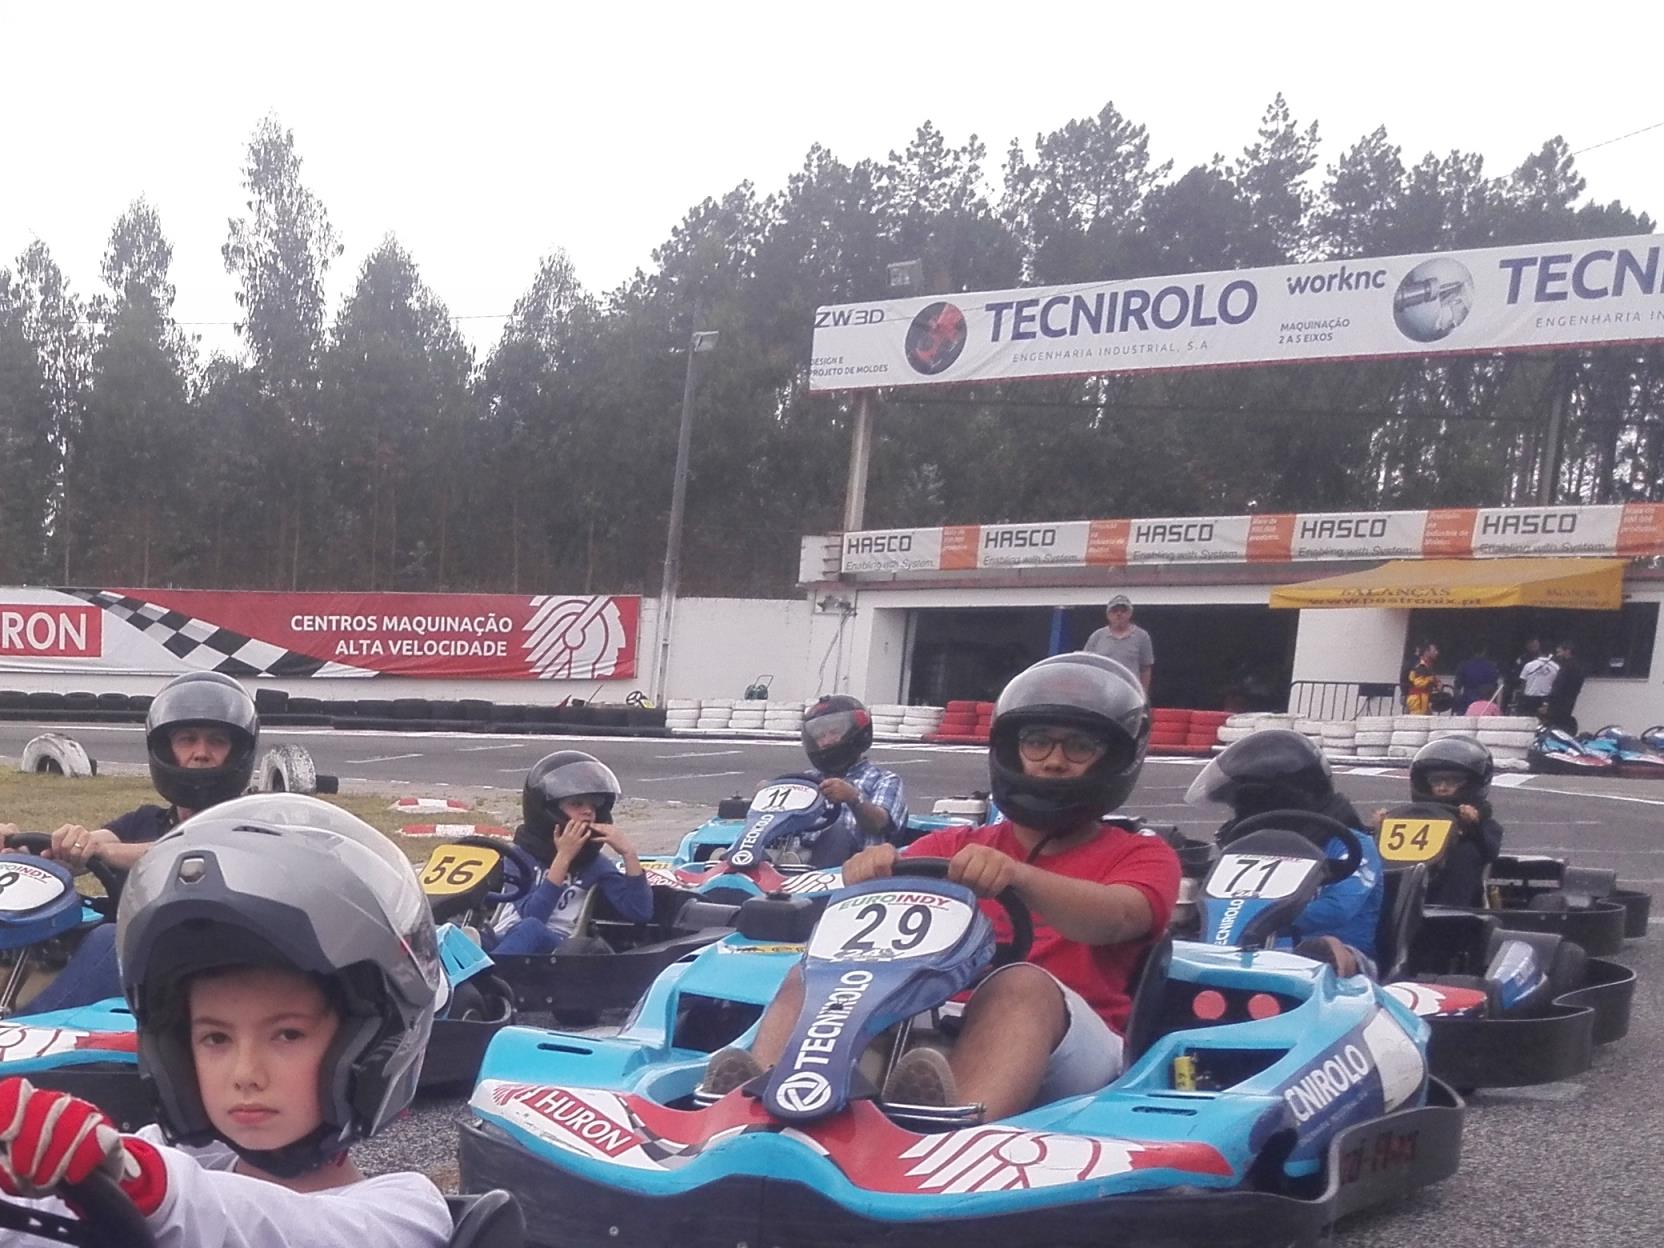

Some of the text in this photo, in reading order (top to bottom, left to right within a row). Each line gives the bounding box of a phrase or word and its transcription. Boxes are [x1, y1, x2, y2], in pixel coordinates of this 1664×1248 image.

[1287, 266, 1387, 295] worknc
[985, 280, 1258, 342] TECNIROLO
[1536, 311, 1642, 328] ENGENHARIA
[1280, 316, 1350, 332] MAQUINAÇÃO
[1305, 332, 1334, 342] EIXOS
[1012, 347, 1093, 363] ENGENHARIA
[845, 366, 855, 375] DE
[857, 364, 888, 374] MOLDES
[1136, 523, 1214, 543] HASCO
[1300, 518, 1387, 539] HASCO
[1482, 513, 1577, 535] HASCO
[848, 535, 912, 554] HASCO
[986, 529, 1056, 549] HASCO
[291, 610, 513, 637] CENTROS MAQUINAÇÃO
[335, 639, 508, 657] ALTA VELOCIDADE
[768, 789, 792, 808] 11
[1387, 824, 1430, 851] 54
[423, 856, 483, 885] 56
[1224, 859, 1283, 893] 71
[838, 894, 953, 911] EUROINDY
[840, 903, 933, 950] 29
[535, 1090, 632, 1151] HURON
